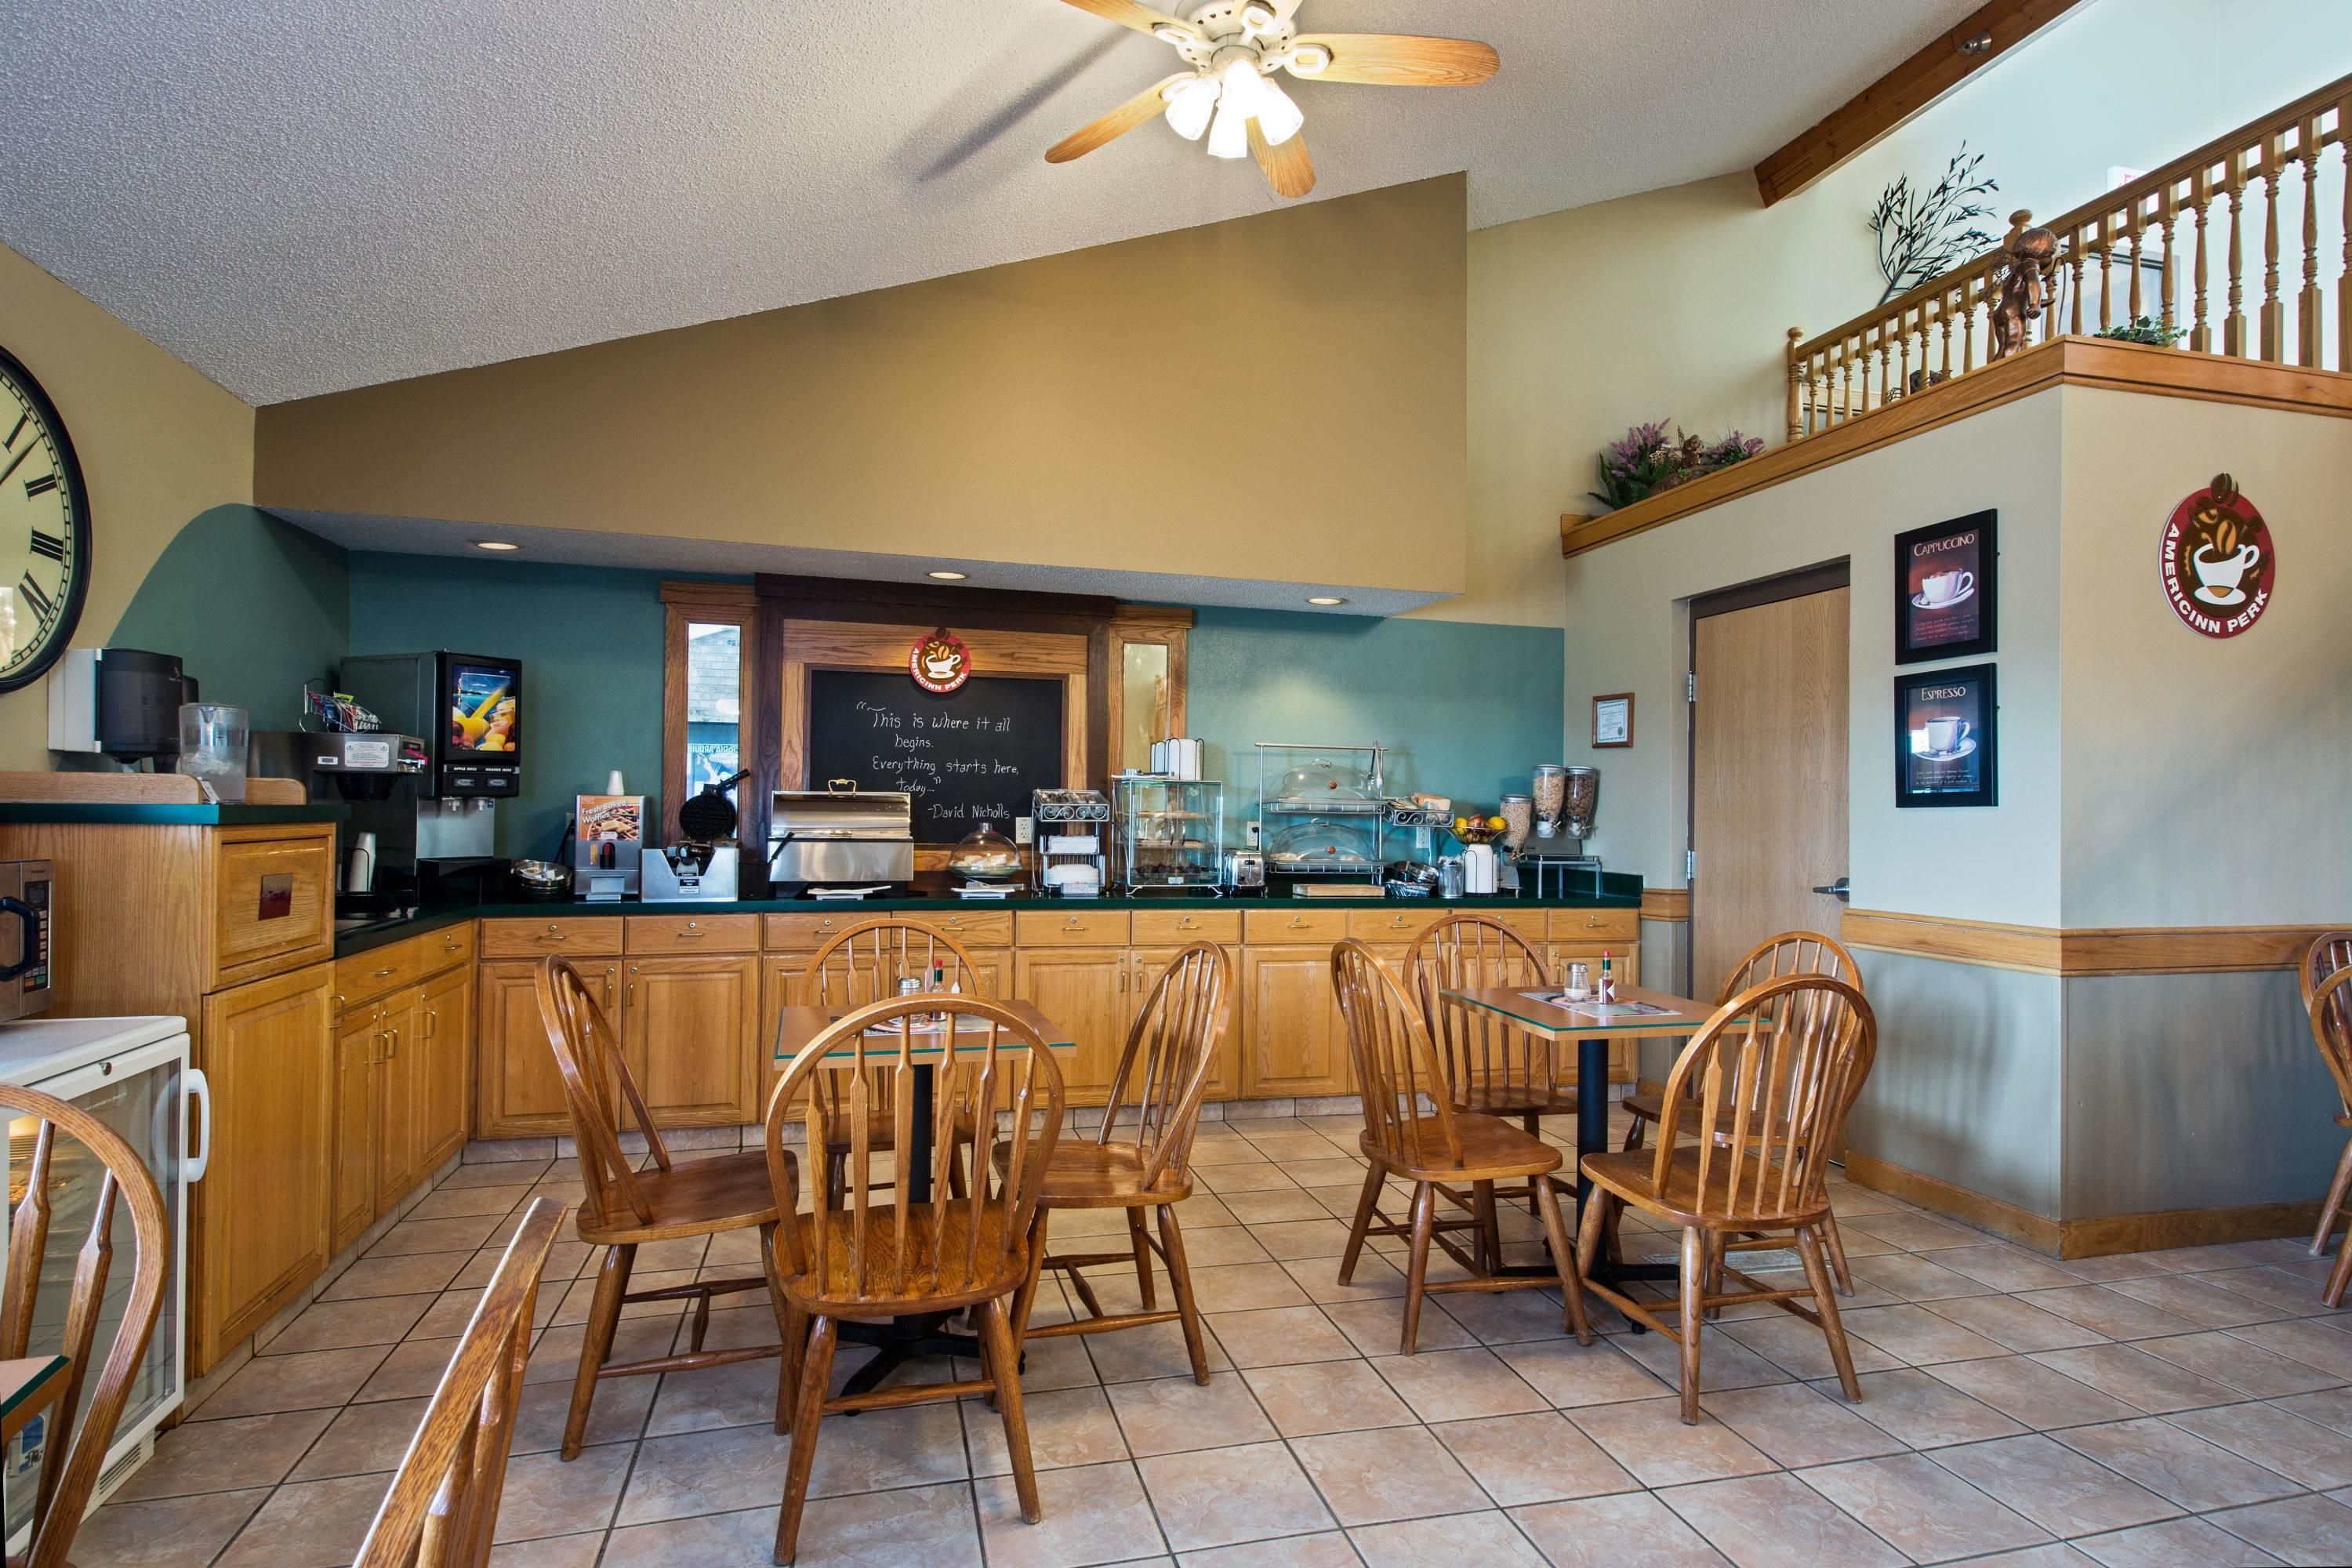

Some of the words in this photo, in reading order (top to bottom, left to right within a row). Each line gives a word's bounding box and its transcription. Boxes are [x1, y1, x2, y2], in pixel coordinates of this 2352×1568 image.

[1914, 533, 1975, 557] CAPPUCCINO
[2164, 522, 2221, 633] AMERICINN
[2226, 588, 2268, 633] PERK
[911, 647, 942, 691] AMERICINN
[944, 671, 967, 690] PERK
[1922, 687, 1966, 701] ESPRESSO
[913, 713, 924, 728] is
[931, 712, 969, 729] where
[976, 717, 990, 730] it
[995, 717, 1011, 732] all
[895, 734, 934, 752] begins.
[873, 756, 936, 775] Everything
[946, 758, 986, 774] starts
[993, 759, 1019, 775] here,
[582, 805, 601, 815] Fresh
[603, 799, 626, 810] Baked
[971, 804, 1010, 819] Nicholls
[582, 811, 610, 824] Waffles
